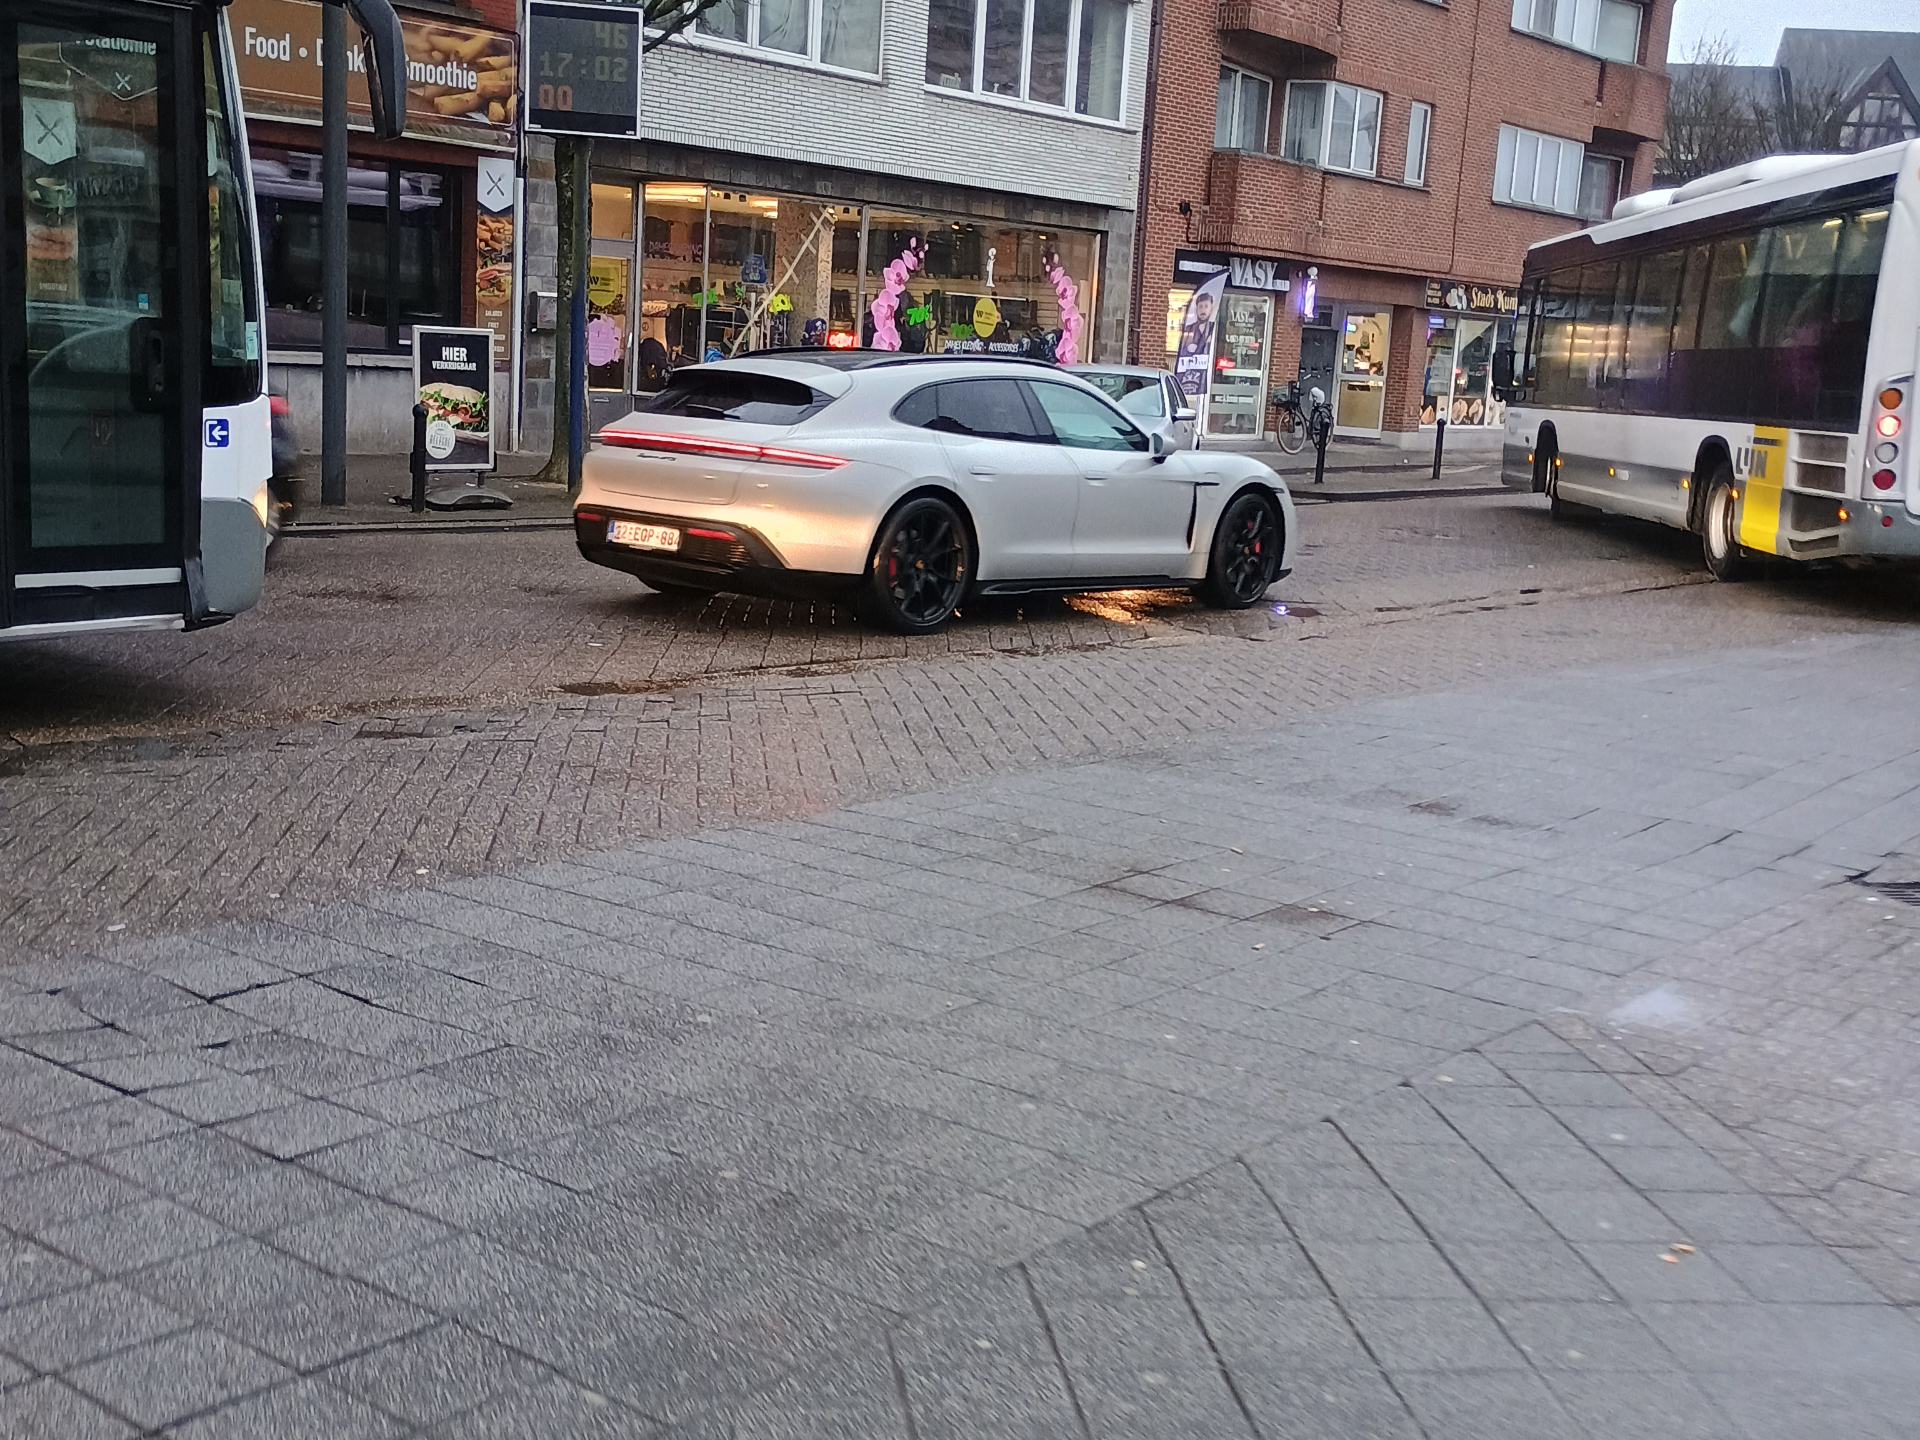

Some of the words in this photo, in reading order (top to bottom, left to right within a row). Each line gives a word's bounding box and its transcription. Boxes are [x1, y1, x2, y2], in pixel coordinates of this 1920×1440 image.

[245, 26, 290, 62] Food
[540, 51, 628, 83] 17:02
[1229, 256, 1278, 289] VASY
[1470, 286, 1495, 309] Stads
[441, 346, 468, 362] HIER
